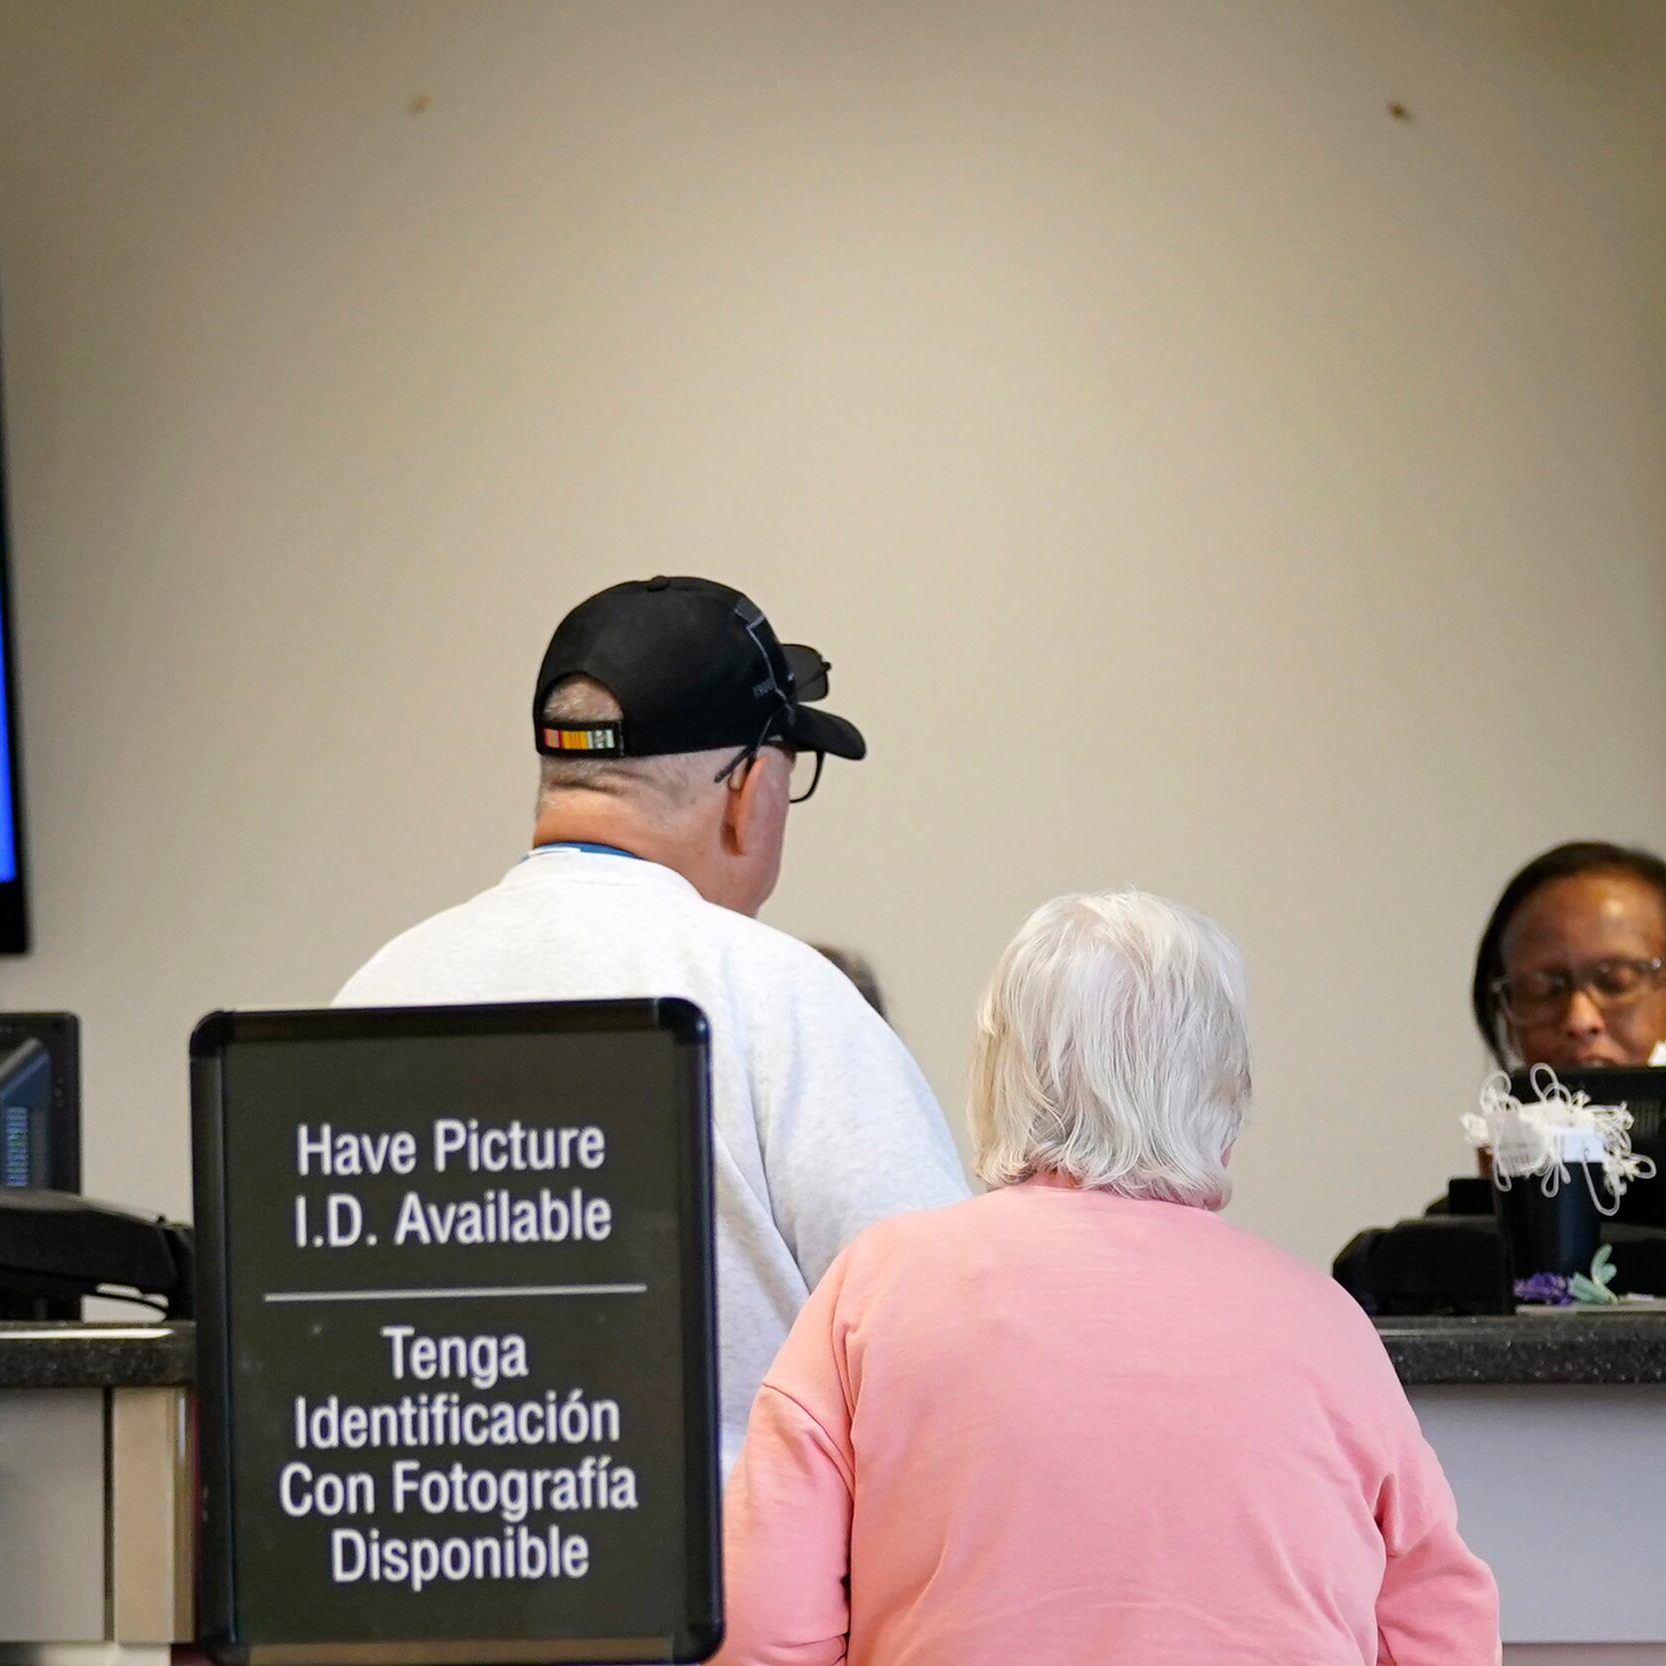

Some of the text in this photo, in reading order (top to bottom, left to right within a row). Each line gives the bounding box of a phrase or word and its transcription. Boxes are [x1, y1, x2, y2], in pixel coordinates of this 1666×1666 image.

[296, 1117, 606, 1177] Have Picture
[294, 1186, 614, 1249] I.D. Available
[380, 1324, 530, 1390] Tenga
[294, 1388, 621, 1450] Identificación
[278, 1456, 639, 1524] Con Fotografía
[331, 1525, 590, 1593] Disponible
